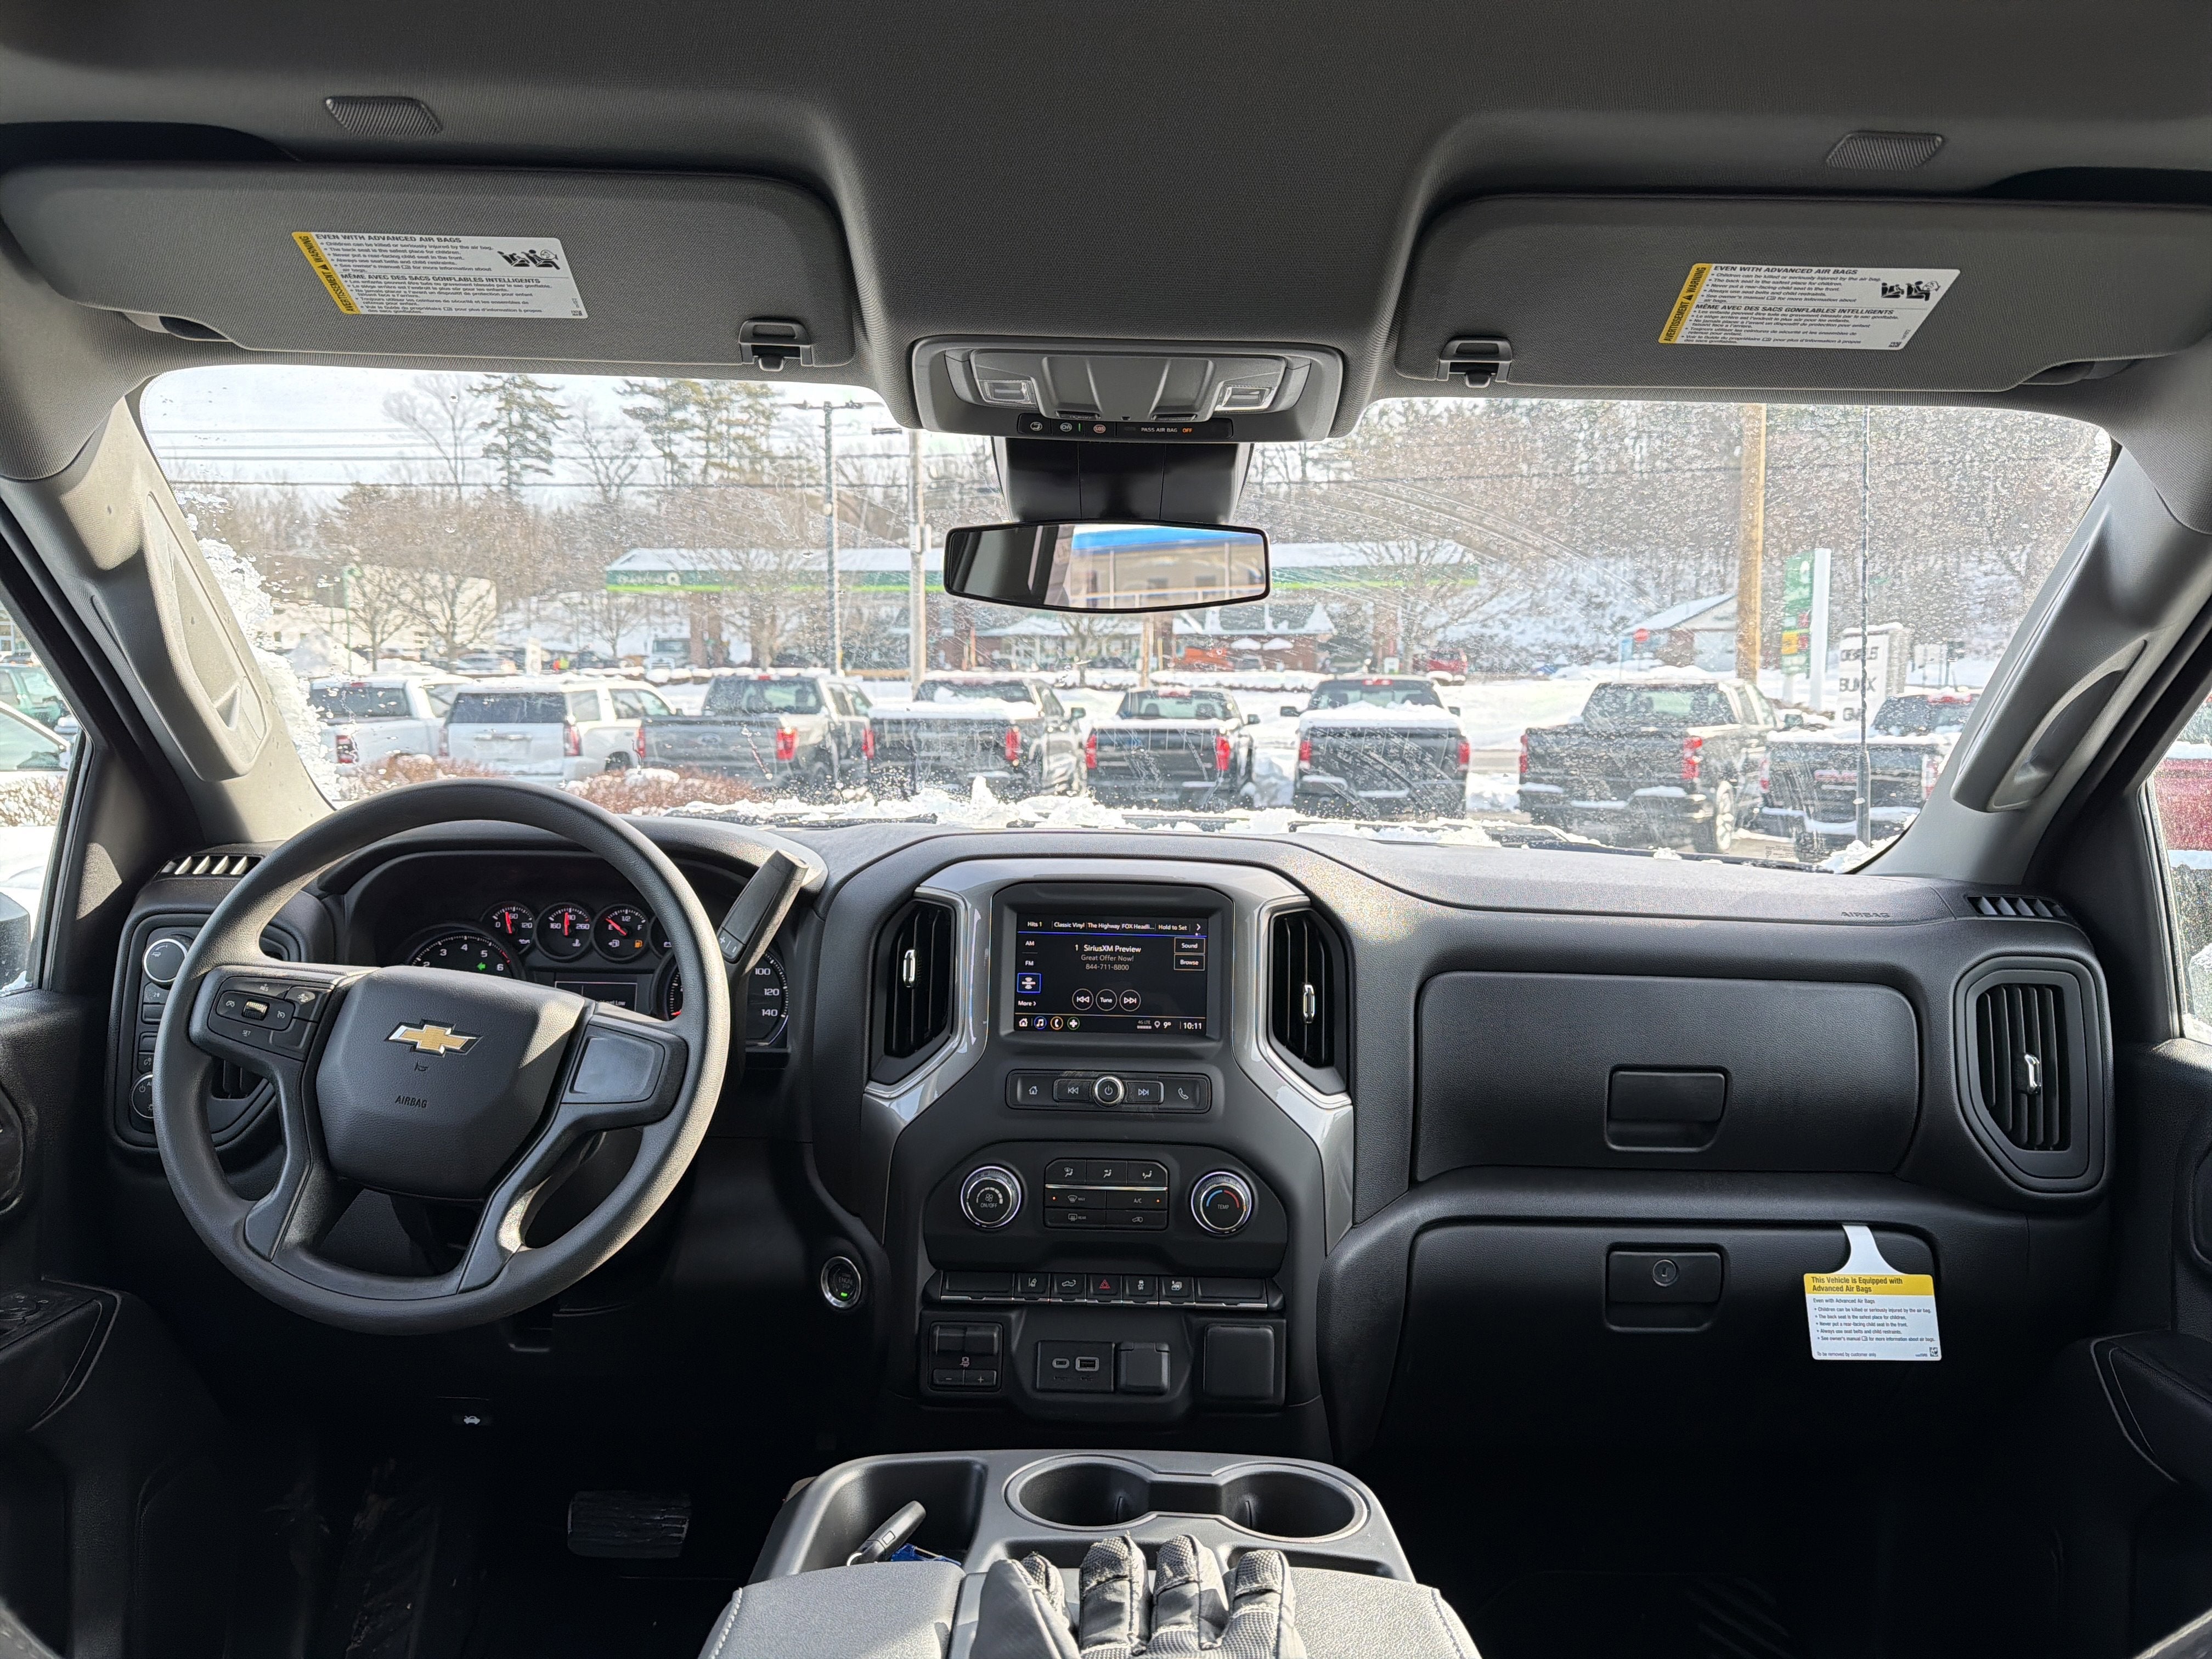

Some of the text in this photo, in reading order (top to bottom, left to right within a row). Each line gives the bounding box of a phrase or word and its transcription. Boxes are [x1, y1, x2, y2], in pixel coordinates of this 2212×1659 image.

[299, 236, 323, 262] WARNING
[321, 271, 356, 312] AVERTISSEMENT
[1686, 267, 1706, 293] WARNING
[1663, 301, 1690, 342] AVERTISSEMENT
[395, 1095, 427, 1108] AIRBAG
